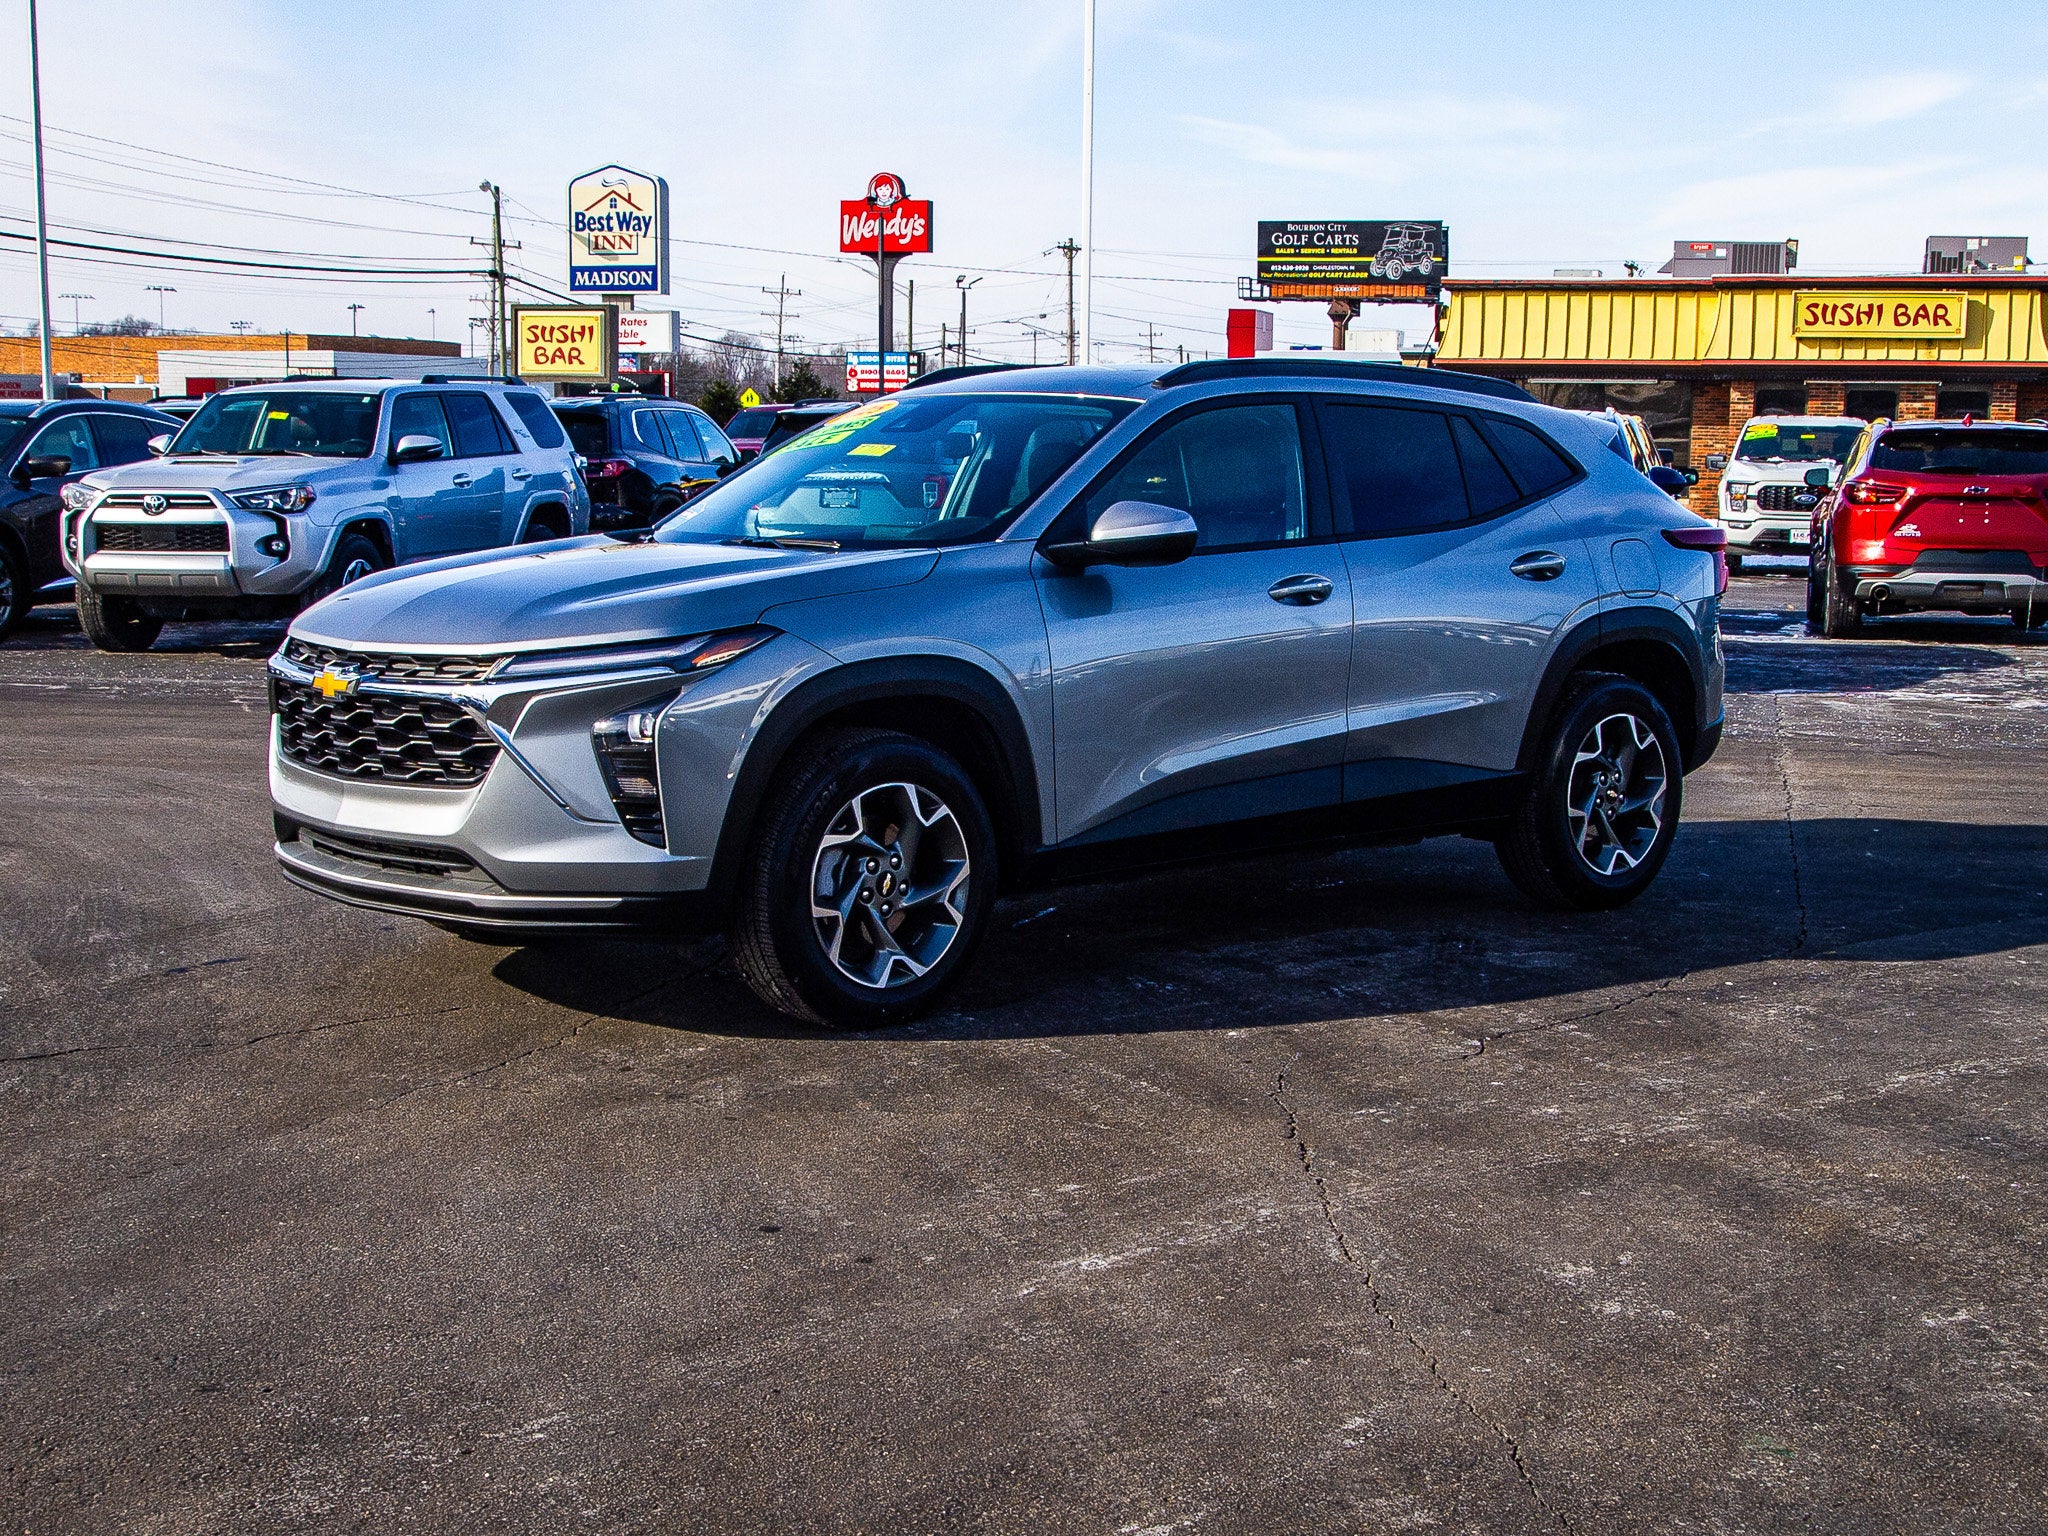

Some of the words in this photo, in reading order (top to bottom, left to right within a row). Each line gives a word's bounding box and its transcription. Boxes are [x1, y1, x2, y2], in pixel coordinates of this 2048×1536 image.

[574, 211, 614, 232] Best
[615, 211, 653, 238] Way
[1287, 223, 1326, 231] BOURBON
[1328, 223, 1348, 231] CITY
[593, 234, 634, 250] INN
[1271, 232, 1309, 245] GOLF
[1313, 232, 1359, 245] CARTS
[575, 271, 653, 286] MADISON
[620, 317, 648, 327] Rates
[1804, 302, 1884, 327] SUSHI
[1893, 302, 1953, 327] BAR
[526, 324, 594, 344] SUSHI
[533, 346, 585, 366] BAR
